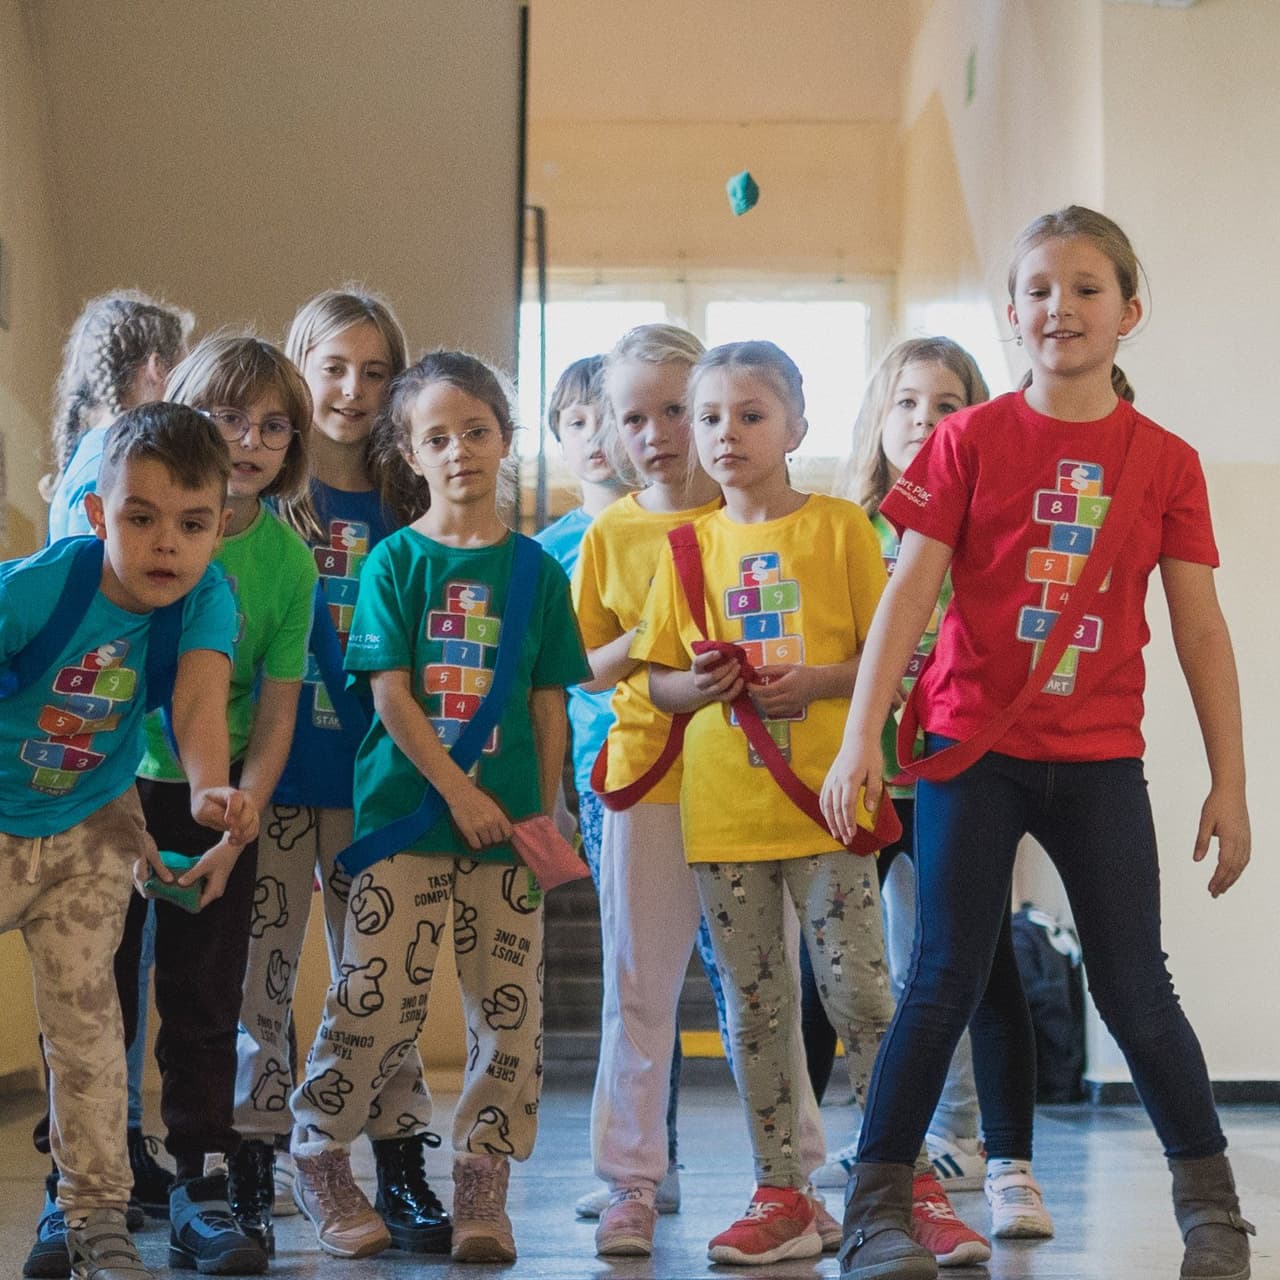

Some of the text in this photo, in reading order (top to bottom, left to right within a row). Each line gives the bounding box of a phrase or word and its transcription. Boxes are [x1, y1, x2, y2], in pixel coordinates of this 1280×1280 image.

[1071, 468, 1089, 490] S
[1051, 501, 1102, 520] 8 9
[342, 526, 357, 547] S
[1070, 531, 1079, 546] 7
[324, 556, 335, 568] 8
[1044, 559, 1056, 571] 5
[752, 560, 768, 581] S
[341, 585, 348, 598] 7
[738, 591, 784, 608] 8 9
[1060, 592, 1069, 605] 4
[459, 590, 475, 610] S
[442, 620, 486, 637] 8 9
[759, 620, 766, 633] 7
[1034, 618, 1085, 639] 2 3
[461, 648, 468, 659] 7
[776, 645, 788, 657] 6
[910, 660, 919, 672] 3
[70, 675, 120, 692] 8 9
[440, 672, 486, 688] 5 6
[86, 703, 96, 713] 7
[456, 701, 466, 713] 4
[56, 716, 69, 727] 5
[438, 726, 446, 738] 2
[38, 750, 88, 768] 2 3
[50, 774, 59, 784] 1
[494, 928, 531, 953] NO ONE
[491, 944, 525, 967] TRUST
[401, 995, 417, 1010] ONE
[332, 1043, 352, 1060] TASK
[491, 1050, 520, 1069] MATE
[486, 1063, 516, 1083] CREW
